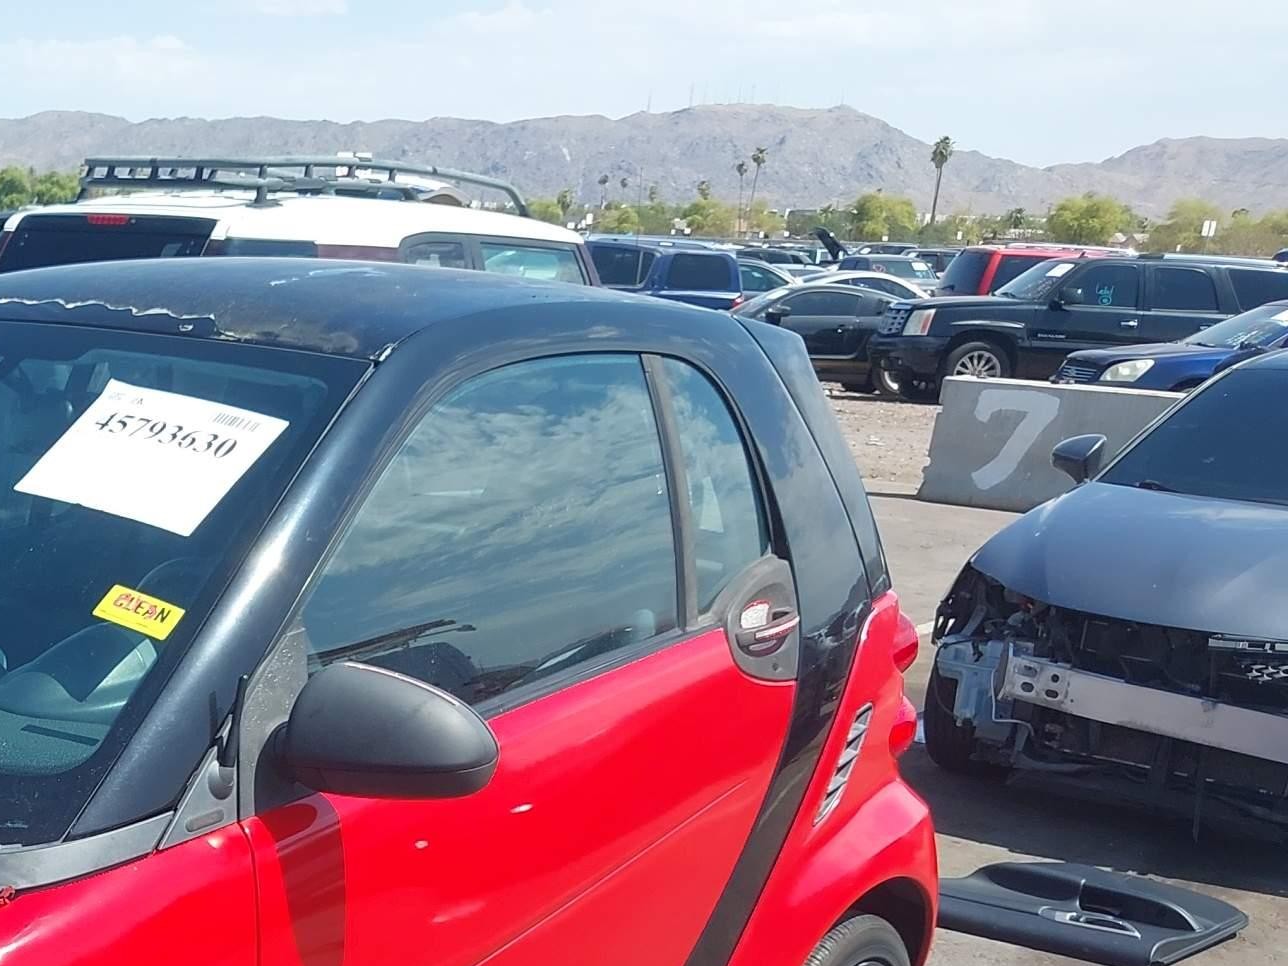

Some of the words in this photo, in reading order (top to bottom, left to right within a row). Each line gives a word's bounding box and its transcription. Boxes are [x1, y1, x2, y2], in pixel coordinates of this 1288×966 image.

[95, 412, 238, 459] 45793630
[971, 389, 1060, 491] 7
[112, 592, 172, 624] CLEAN
